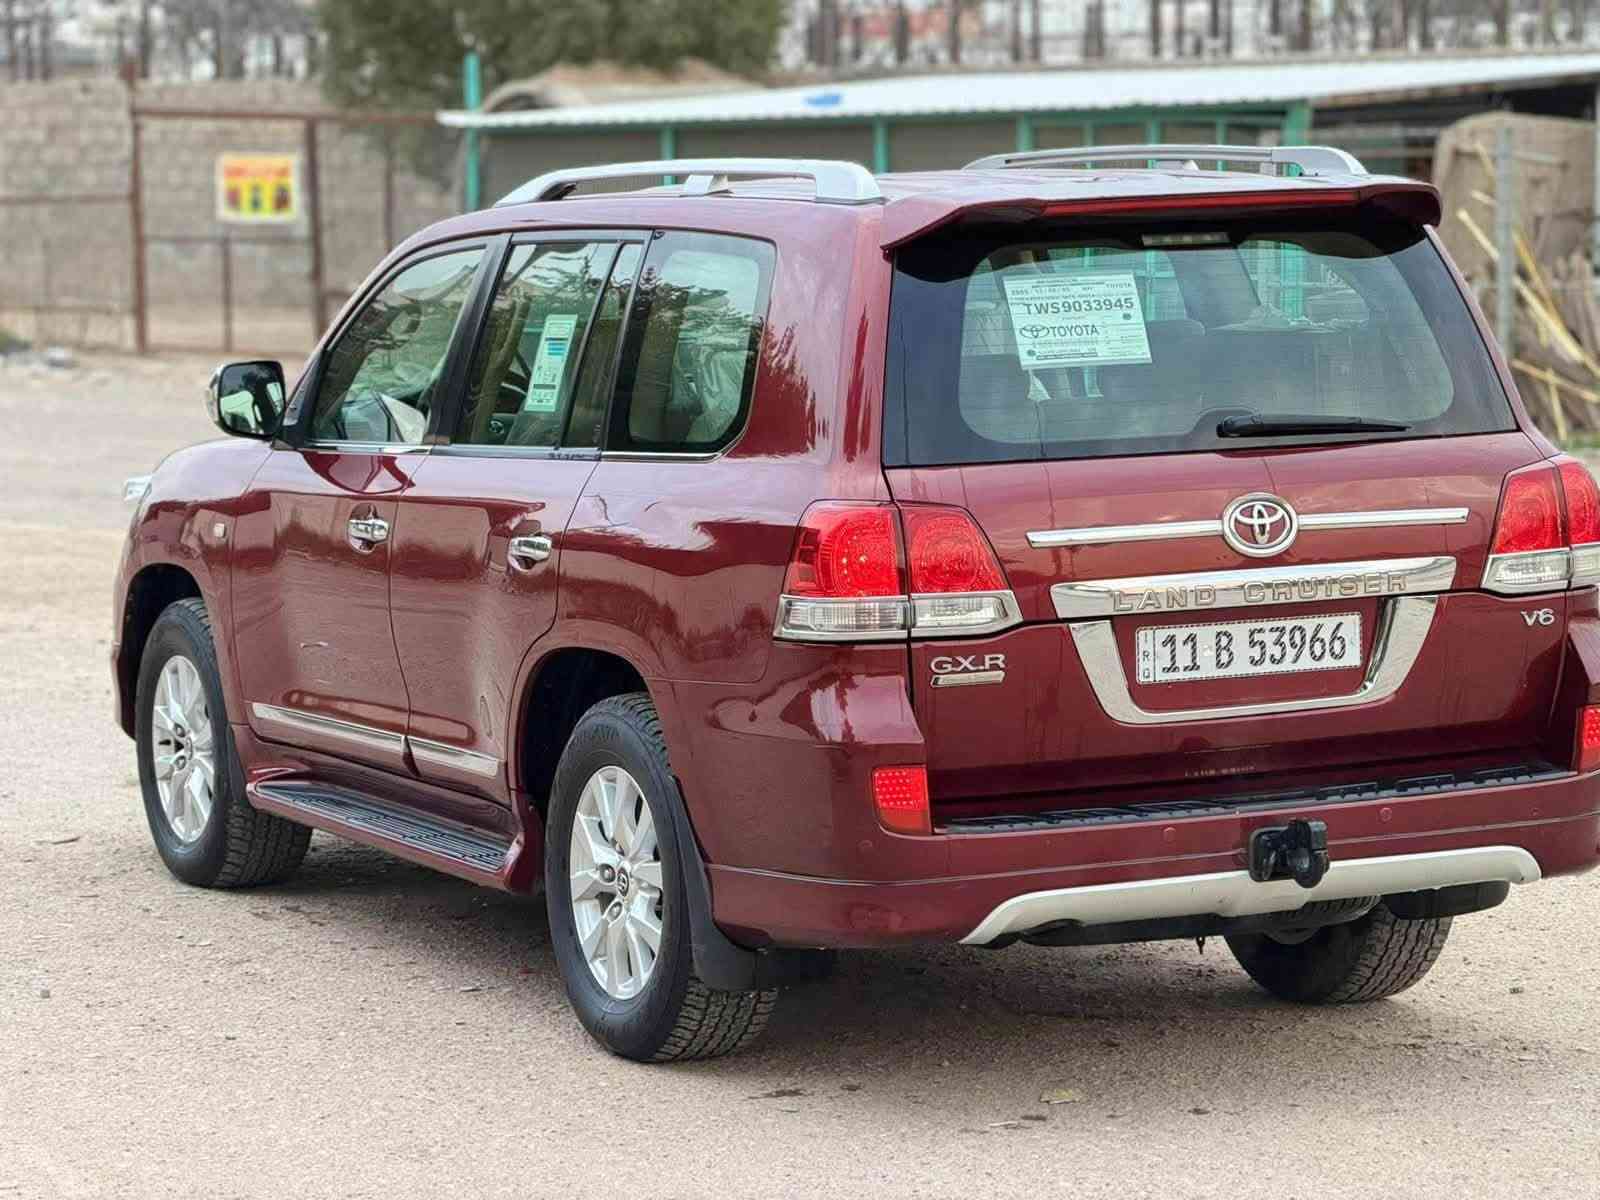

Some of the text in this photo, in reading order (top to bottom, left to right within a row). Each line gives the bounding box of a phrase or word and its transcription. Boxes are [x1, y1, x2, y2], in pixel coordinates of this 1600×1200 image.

[1023, 298, 1134, 315] TWS9033945
[1049, 324, 1100, 338] TOYOTA
[1113, 571, 1408, 612] LAND CRUISER
[1520, 608, 1555, 626] V6
[1161, 621, 1347, 673] 11 B 53966
